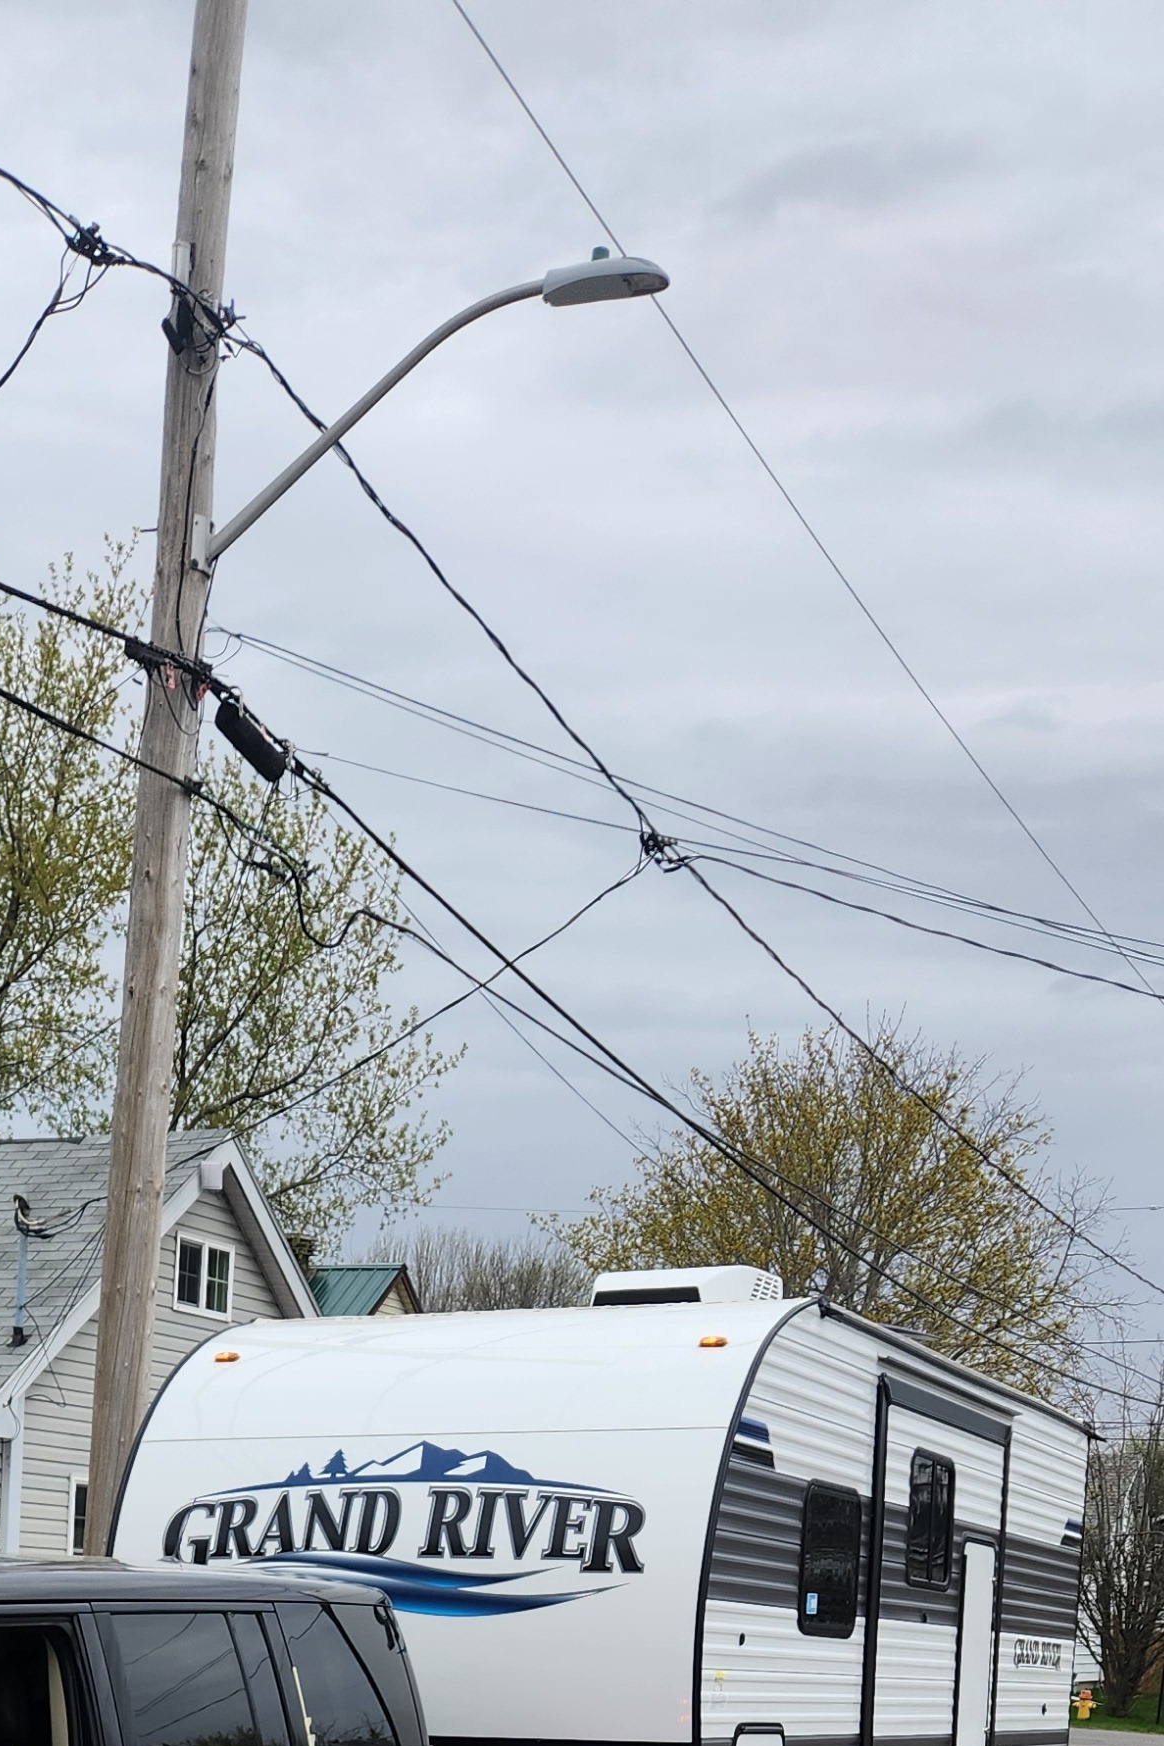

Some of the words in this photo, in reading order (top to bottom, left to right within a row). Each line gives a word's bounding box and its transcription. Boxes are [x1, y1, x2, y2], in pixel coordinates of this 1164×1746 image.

[162, 1486, 403, 1566] GRAND
[416, 1485, 646, 1574] RIVER
[1013, 1638, 1040, 1669] GRAND
[1040, 1640, 1062, 1672] RIVER
